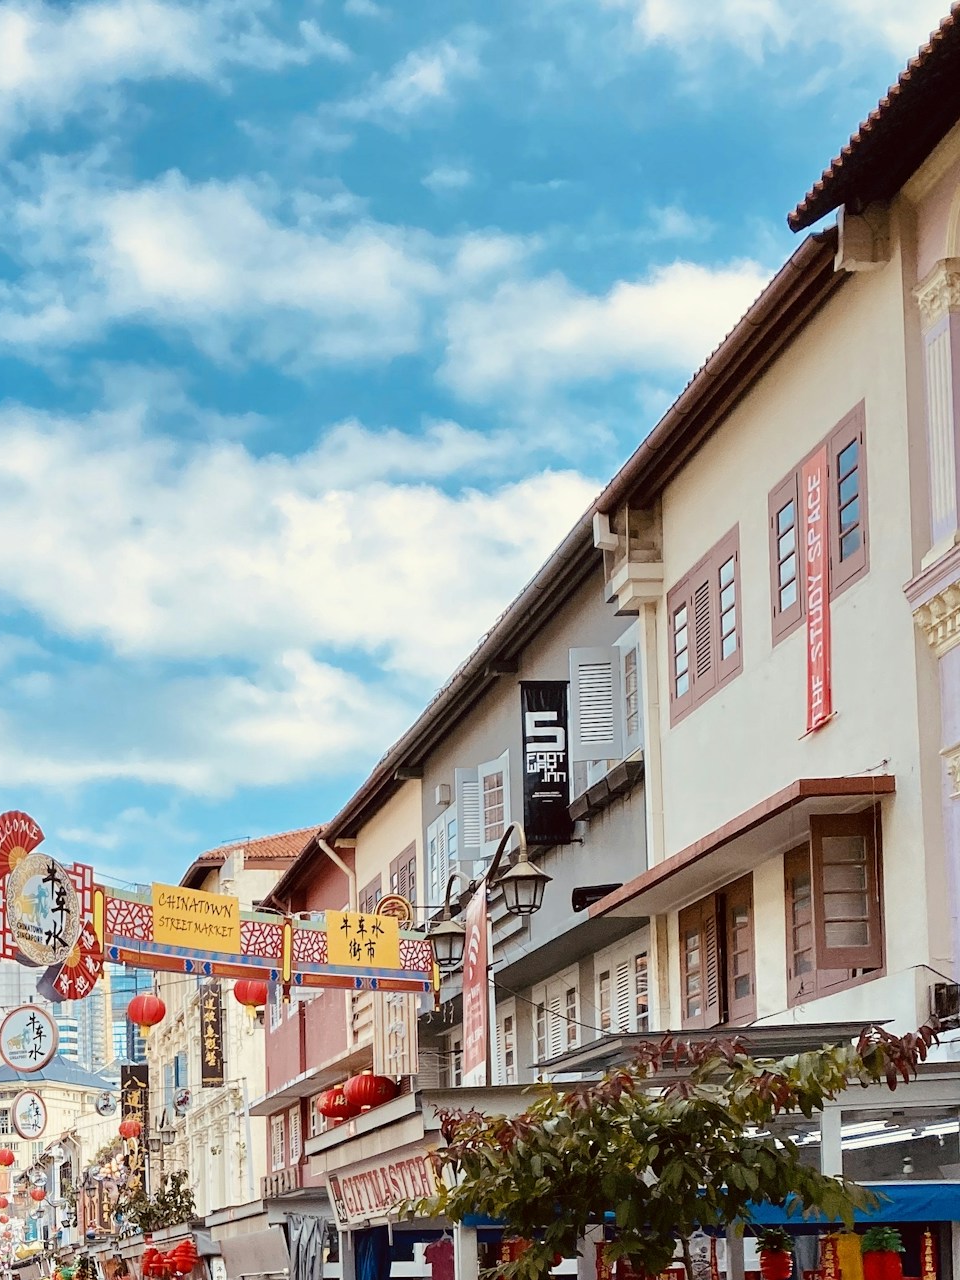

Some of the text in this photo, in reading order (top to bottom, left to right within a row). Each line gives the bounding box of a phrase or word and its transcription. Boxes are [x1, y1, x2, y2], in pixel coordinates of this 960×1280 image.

[807, 467, 821, 563] SPACE
[808, 573, 823, 662] STUDY
[525, 711, 565, 752] 5
[527, 752, 566, 763] FOOT
[42, 859, 70, 953] 牛车水
[158, 892, 234, 918] CHINATOWN
[16, 922, 43, 934] CHINATOWN
[16, 931, 43, 943] SINGAPORE
[158, 917, 234, 938] STREET MARKET
[340, 916, 385, 938] 牛车水
[349, 939, 376, 963] 街市
[26, 1012, 47, 1061] 牛车水
